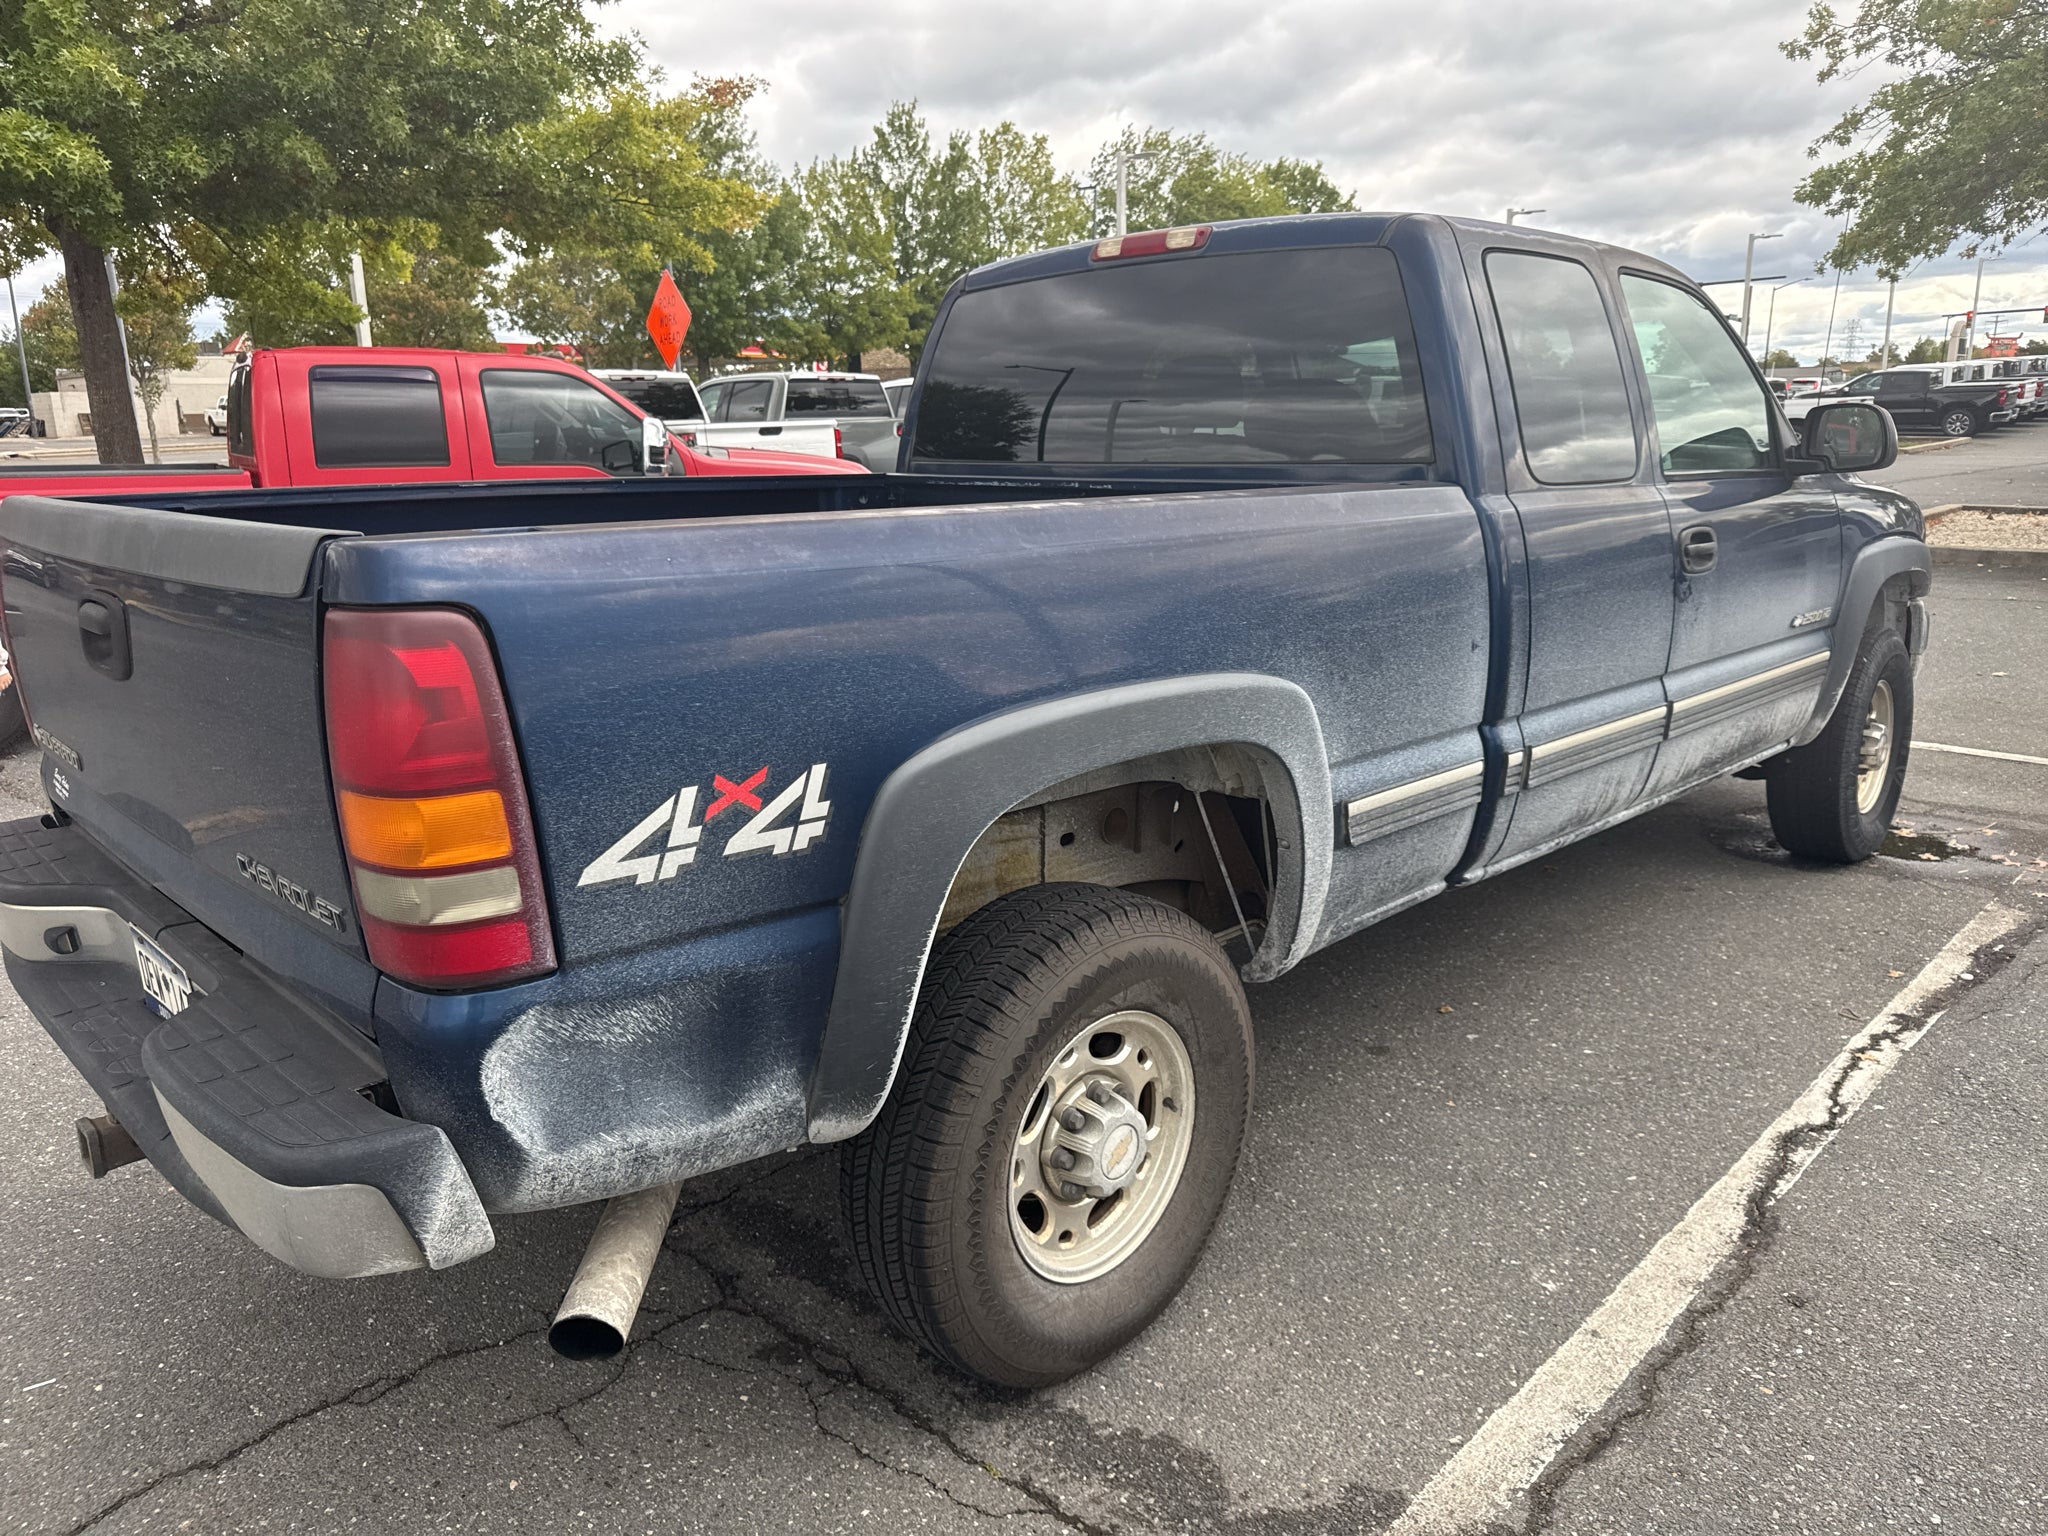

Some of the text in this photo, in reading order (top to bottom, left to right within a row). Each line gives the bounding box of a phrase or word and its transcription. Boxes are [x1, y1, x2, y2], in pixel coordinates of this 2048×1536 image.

[658, 295, 677, 309] ROAD
[660, 313, 678, 329] WORK
[660, 331, 681, 345] AHEAD
[236, 853, 343, 932] CHEVROLET
